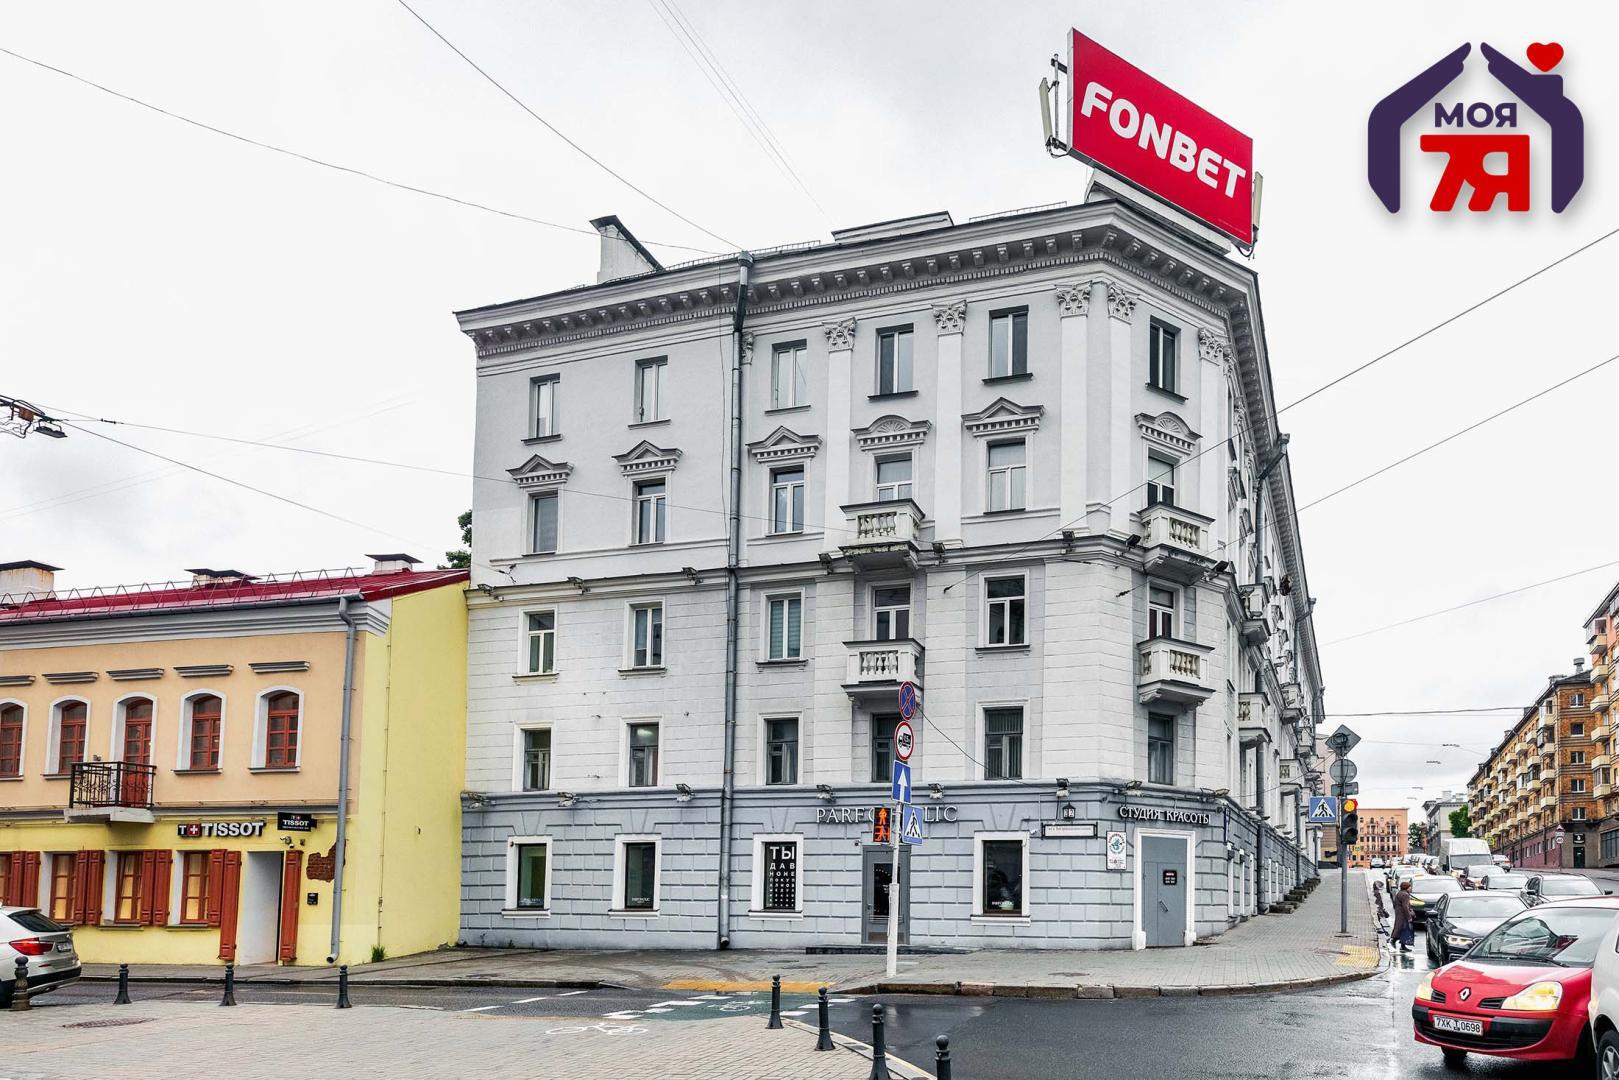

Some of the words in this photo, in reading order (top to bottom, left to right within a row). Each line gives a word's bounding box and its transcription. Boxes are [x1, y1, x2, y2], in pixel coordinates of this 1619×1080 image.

[1080, 81, 1246, 198] FONBET
[816, 806, 957, 823] PARFLIC
[1119, 806, 1160, 820] СТУДИЯ
[1166, 810, 1211, 824] КРАСОТЫ
[201, 822, 264, 837] TISSOT
[282, 819, 310, 827] TISSOT
[769, 846, 795, 860] ТЫ
[1461, 1021, 1481, 1033] 0698
